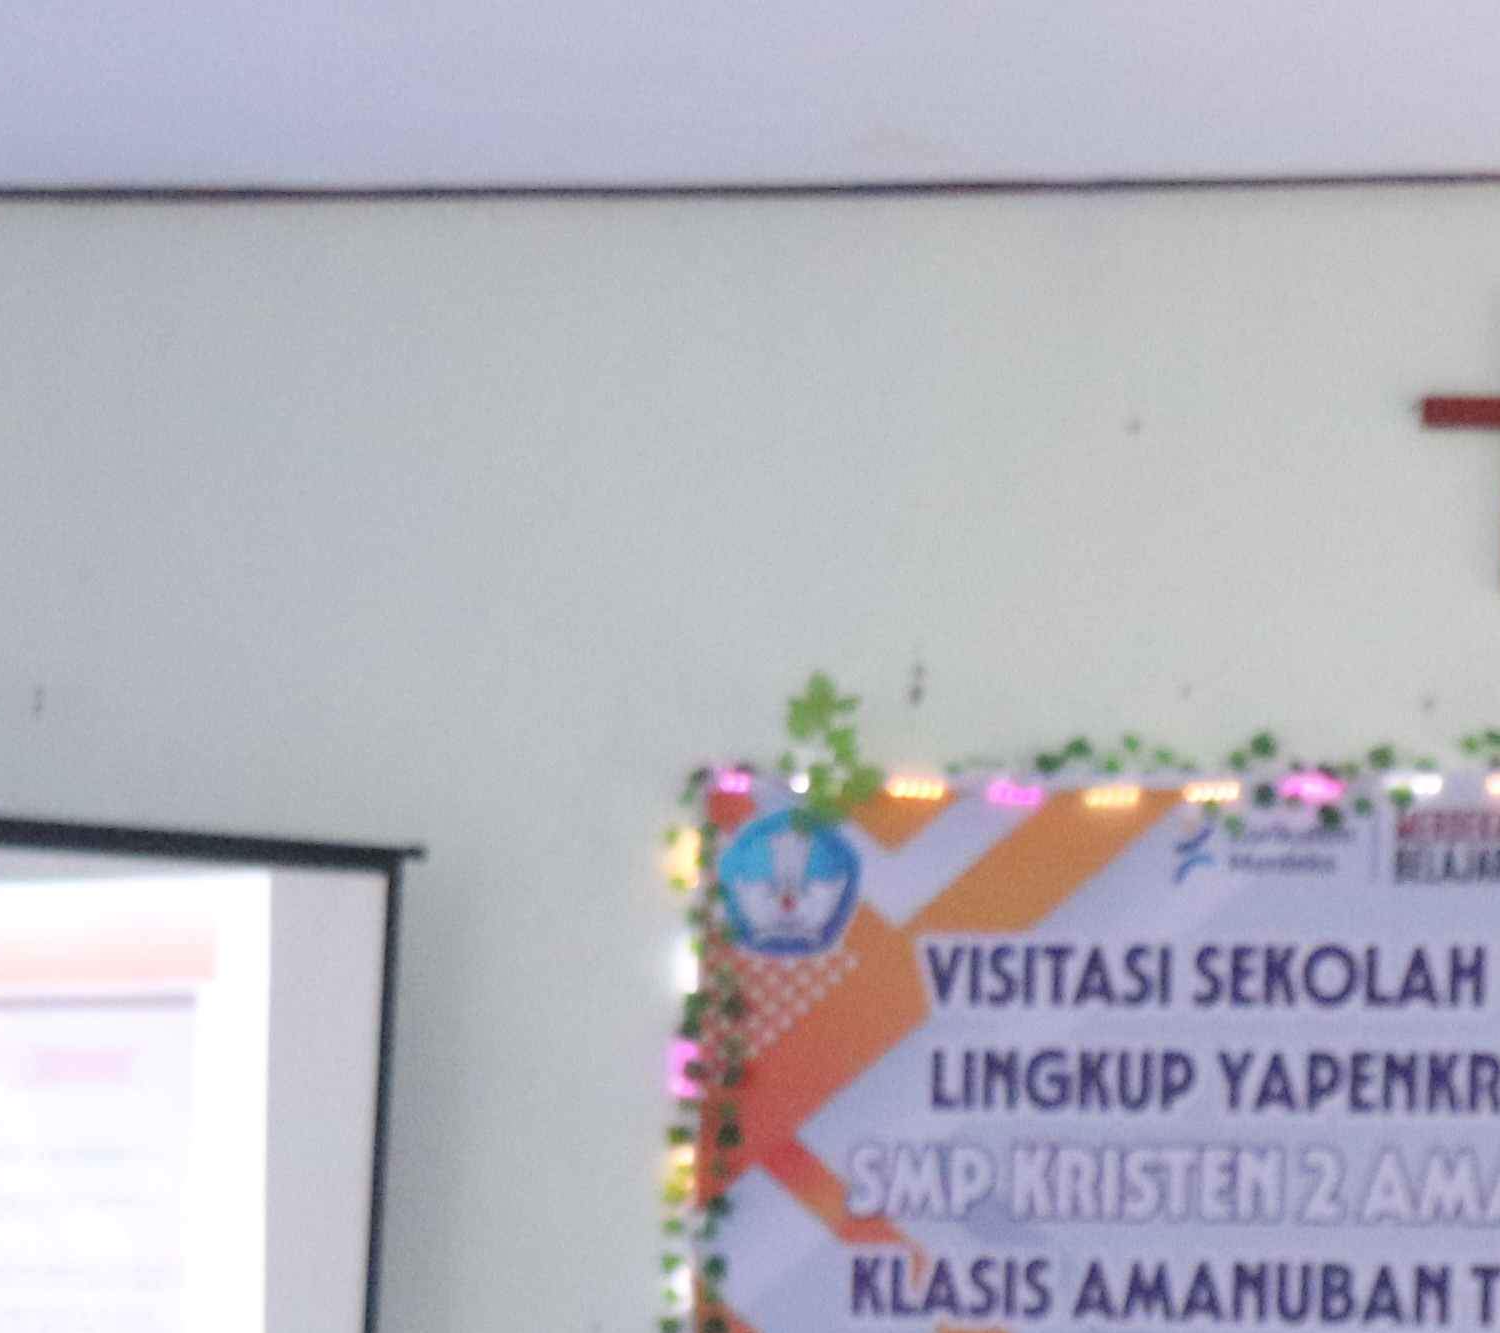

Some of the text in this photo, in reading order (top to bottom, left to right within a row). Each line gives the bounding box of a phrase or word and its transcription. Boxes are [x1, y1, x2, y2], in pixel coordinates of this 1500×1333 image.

[926, 943, 1172, 1007] VISITASI
[1193, 943, 1486, 1007] SEKOLAH
[929, 1049, 1197, 1112] LINGKUP
[848, 1142, 996, 1222] SMP
[1010, 1145, 1288, 1226] KRISTEN
[1300, 1148, 1348, 1227] 2
[850, 1256, 1052, 1317] KLASIS
[1071, 1259, 1454, 1325] AMANUBAN
